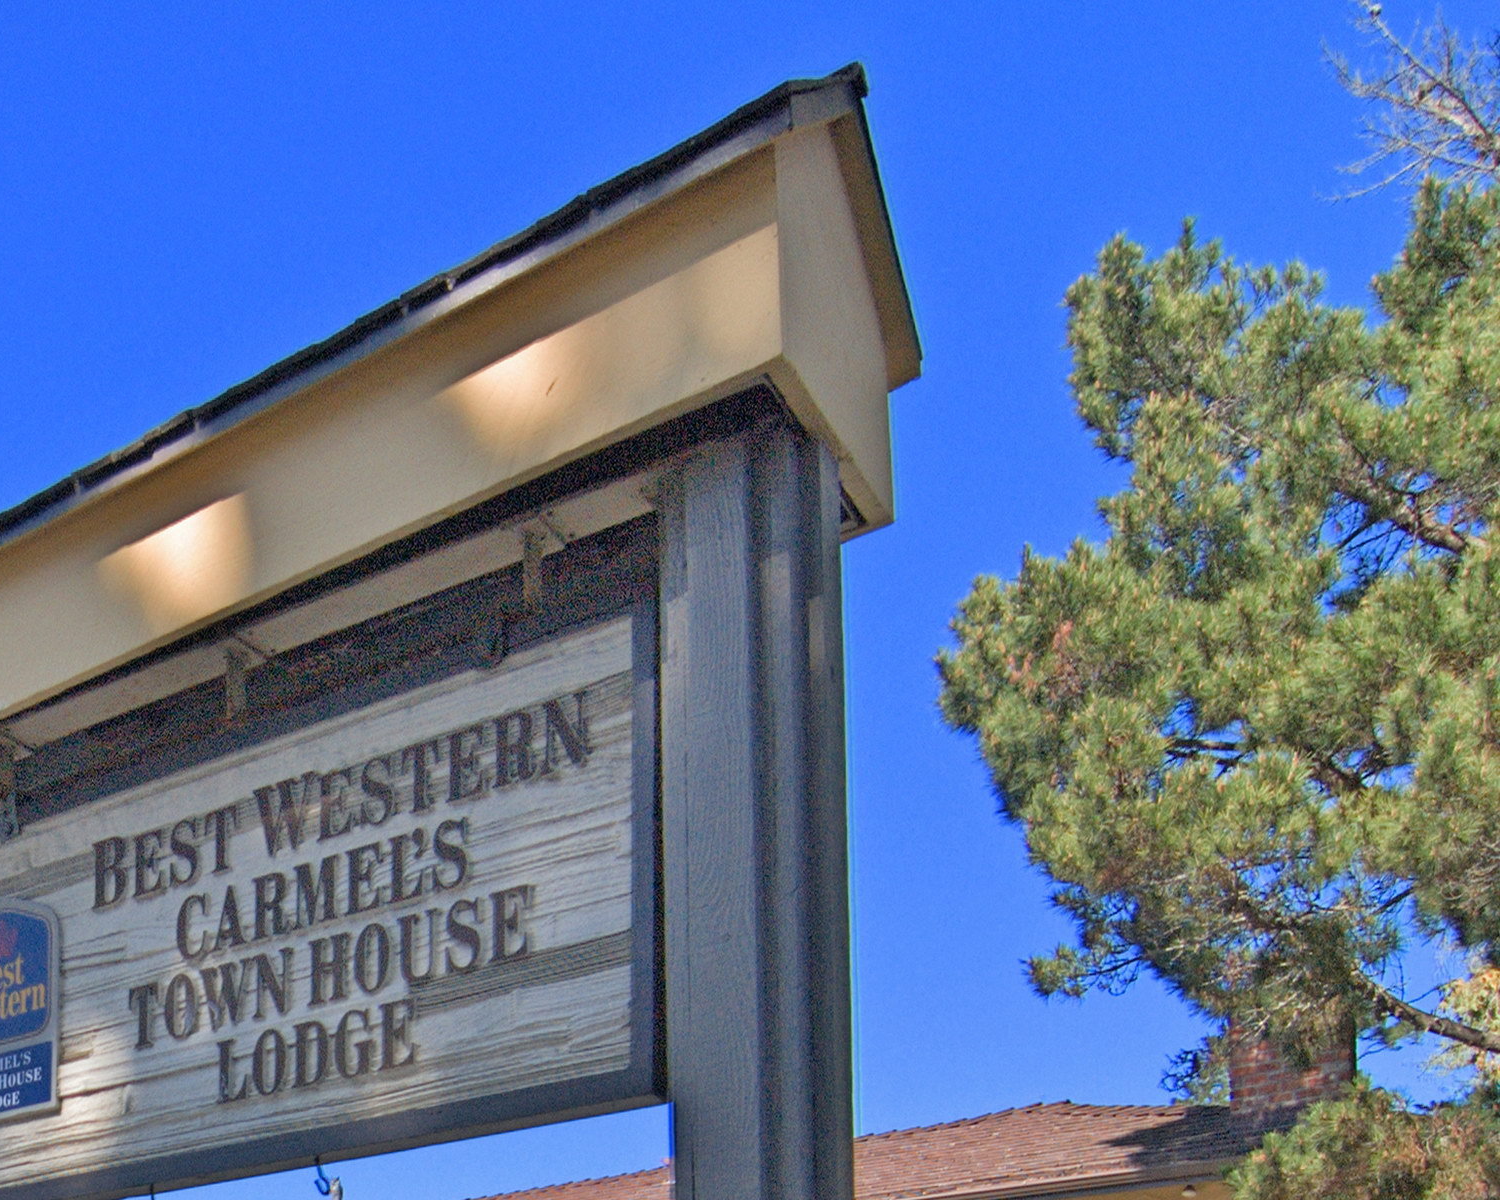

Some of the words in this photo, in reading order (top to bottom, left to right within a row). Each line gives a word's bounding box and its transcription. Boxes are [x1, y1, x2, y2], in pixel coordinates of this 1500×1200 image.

[92, 803, 240, 911] BEST
[254, 692, 594, 857] WESTERN
[176, 816, 471, 960] CARMEL'S
[129, 947, 293, 1049] TOWN
[307, 884, 536, 1005] HOUSE
[217, 1000, 420, 1102] LODGE
